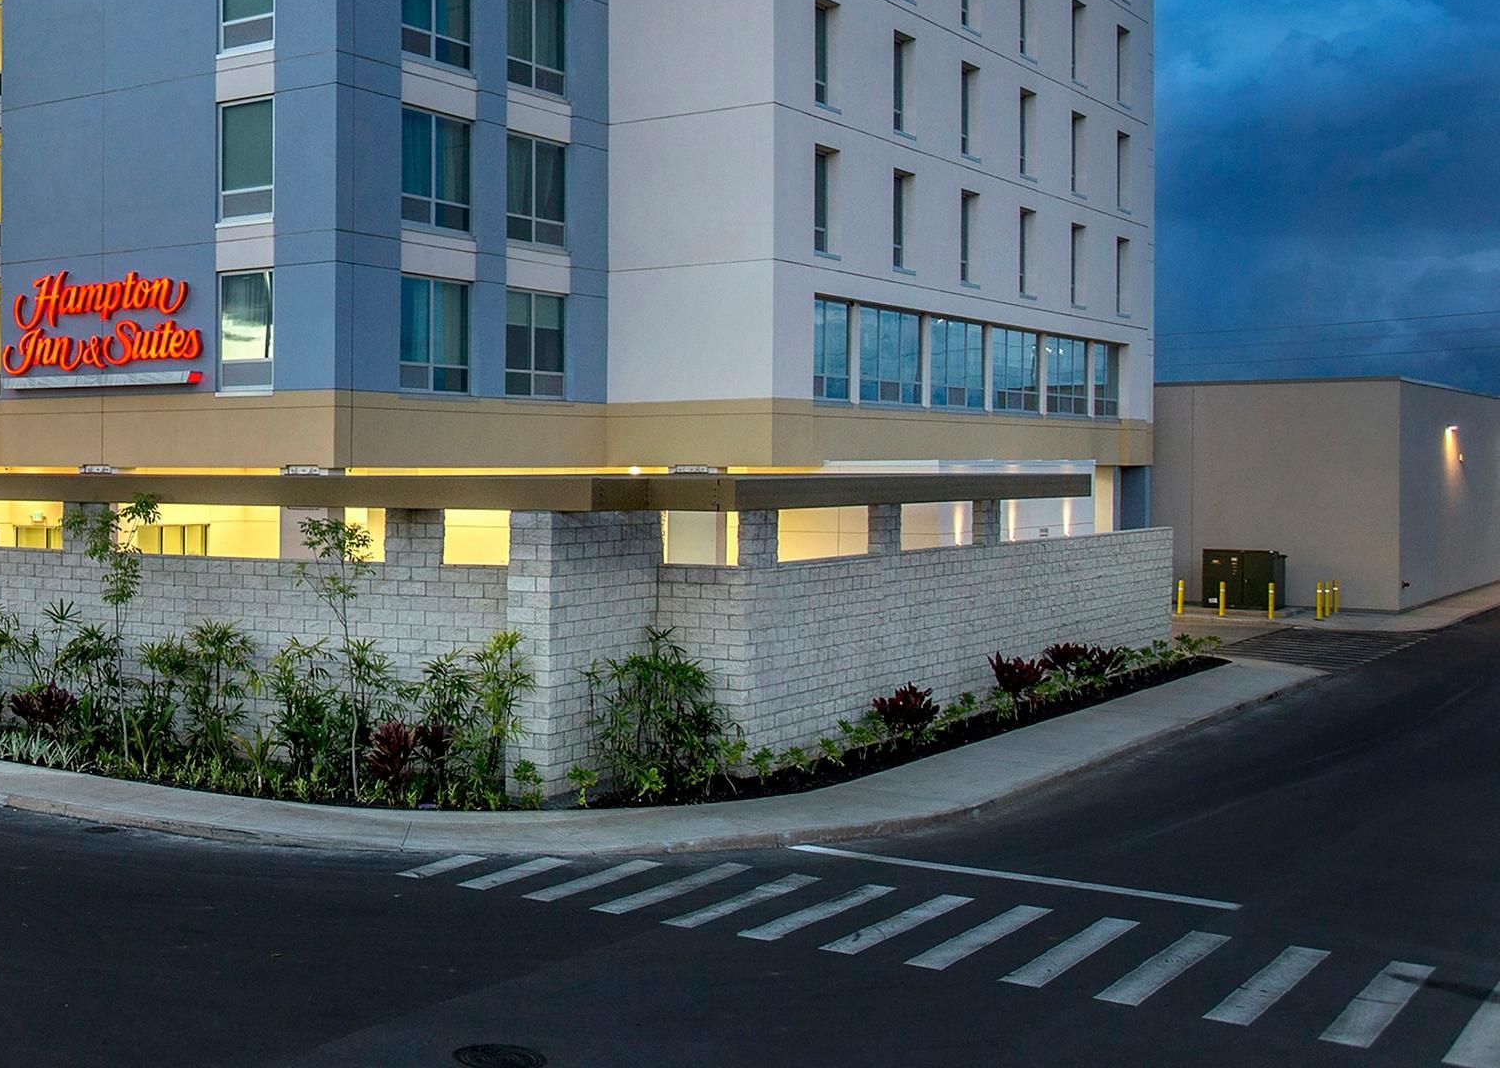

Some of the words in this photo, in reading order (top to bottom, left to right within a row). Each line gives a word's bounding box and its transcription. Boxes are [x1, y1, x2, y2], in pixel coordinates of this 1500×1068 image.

[13, 270, 189, 330] Hampton
[2, 327, 86, 376] Inn
[103, 319, 203, 366] Suites
